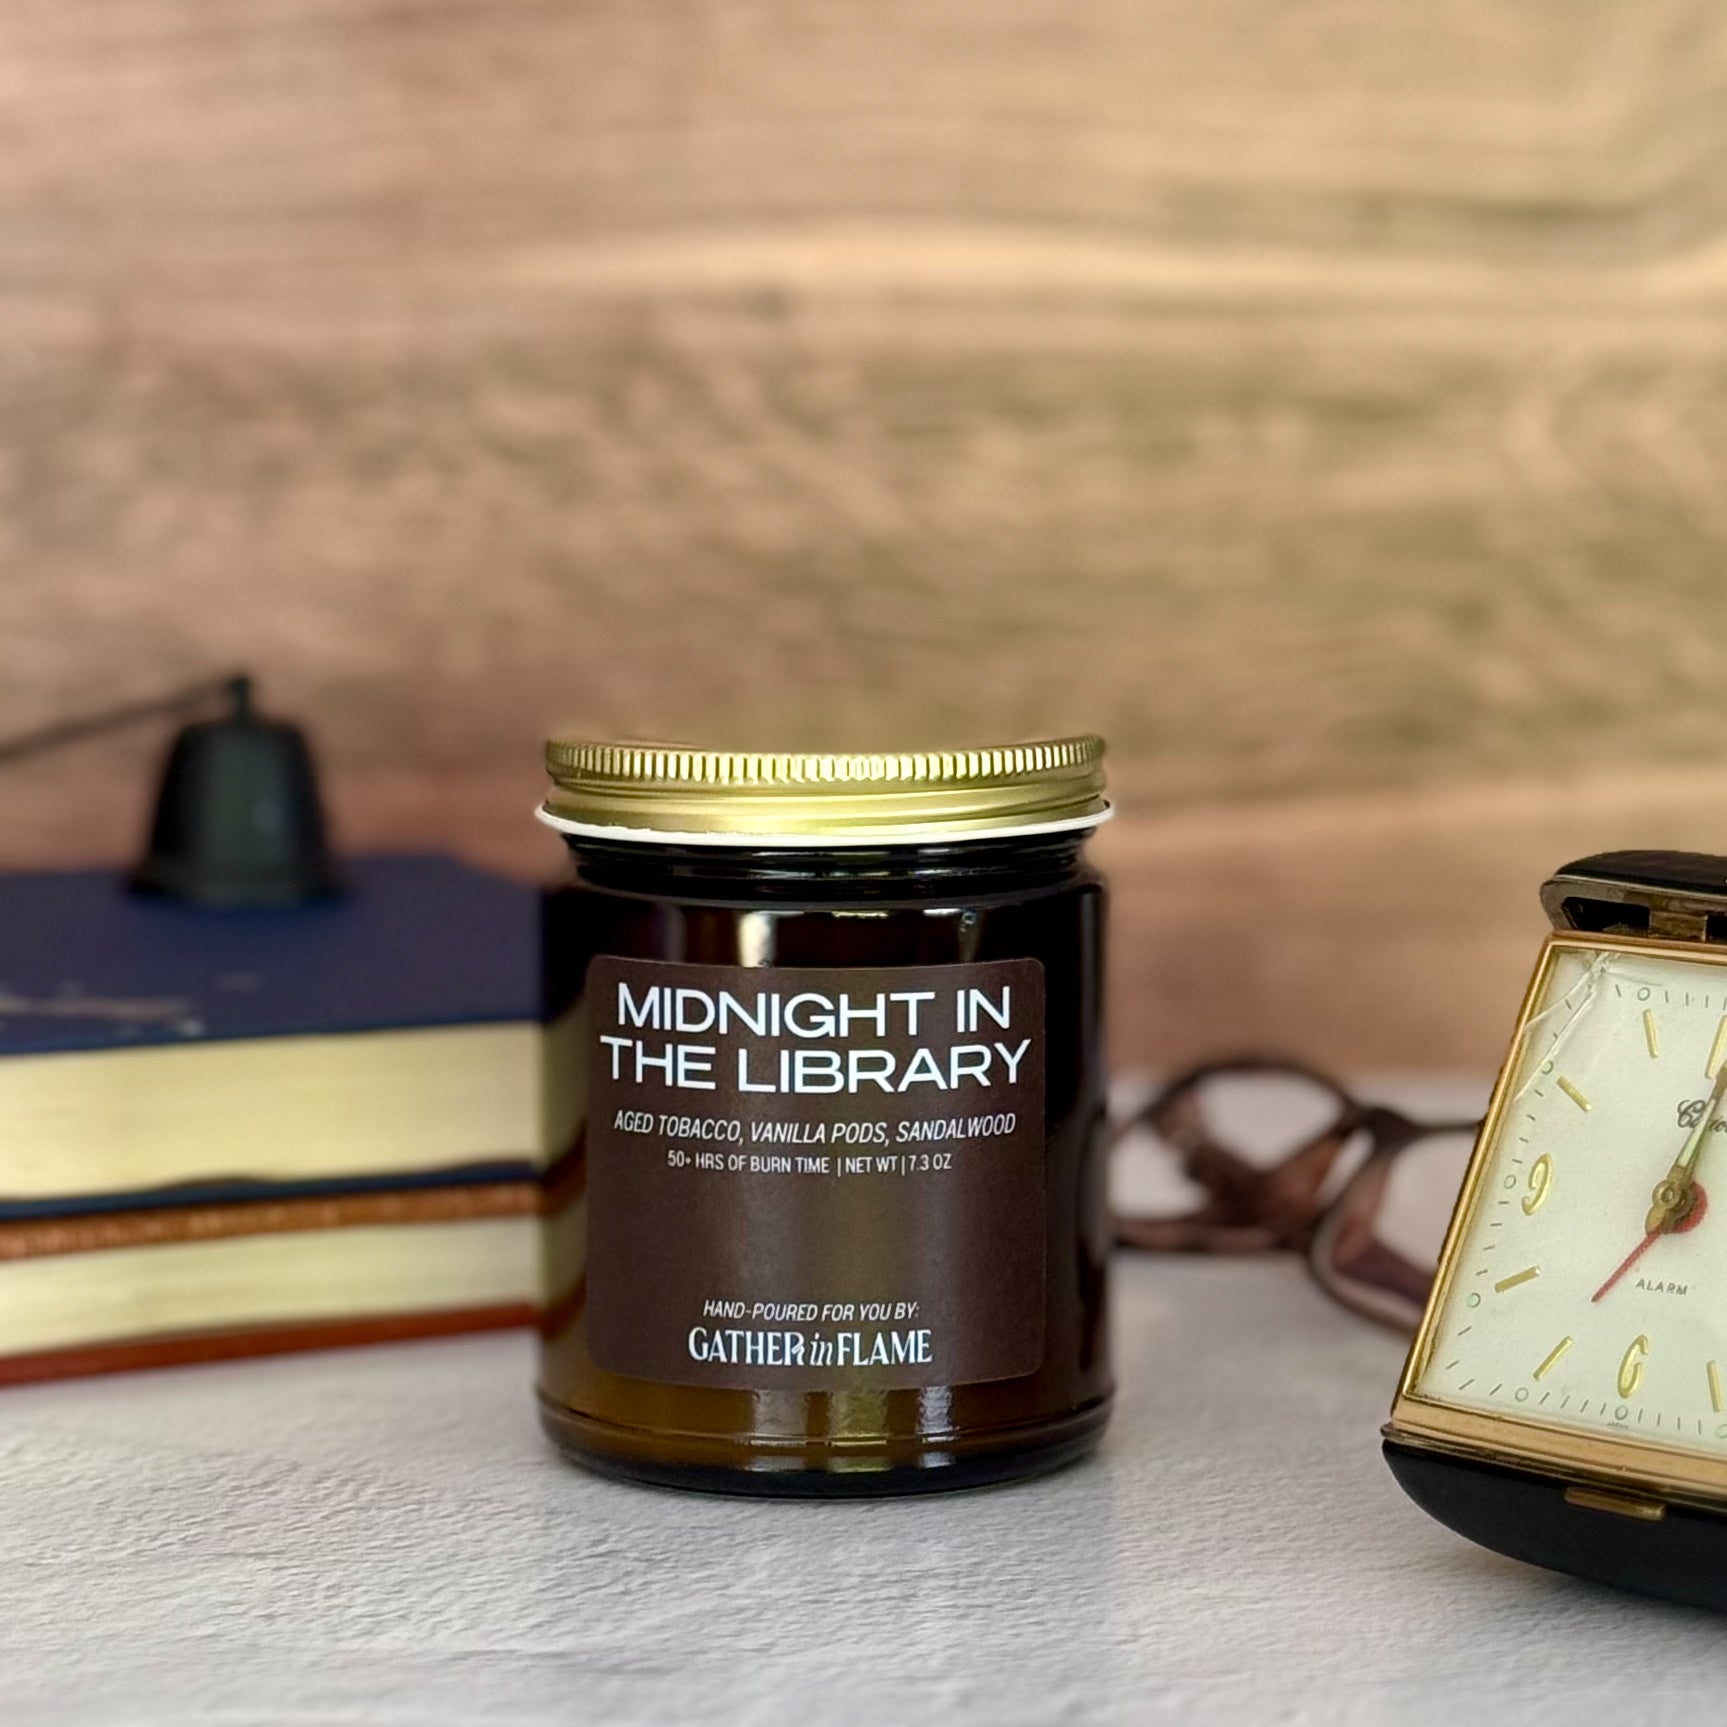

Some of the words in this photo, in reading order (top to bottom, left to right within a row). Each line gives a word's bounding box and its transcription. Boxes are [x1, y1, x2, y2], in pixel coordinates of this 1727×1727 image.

[618, 982, 935, 1038] MIDNIGHT
[956, 986, 1010, 1033] IN
[600, 1035, 716, 1090] THE
[738, 1038, 1031, 1094] LIBRARY
[614, 1109, 654, 1134] AGED
[658, 1114, 745, 1145] TOBACCO,
[751, 1121, 826, 1144] VANILLA
[831, 1121, 890, 1147] PODS,
[895, 1112, 1016, 1143] SANDALWOOD
[667, 1149, 692, 1169] 50+
[695, 1152, 724, 1171] HRS
[728, 1154, 748, 1171] OF
[750, 1155, 791, 1173] BURN
[795, 1156, 830, 1174] TIME
[845, 1156, 874, 1174] NET
[875, 1155, 899, 1172] WT
[933, 1153, 952, 1170] OZ
[1635, 1278, 1688, 1296] ALARM
[702, 1299, 818, 1322] HAND-POURED
[820, 1303, 854, 1322] FOR
[858, 1303, 892, 1321] YOU
[688, 1326, 805, 1366] GATHER
[809, 1332, 834, 1366] in
[836, 1329, 933, 1366] FLAME
